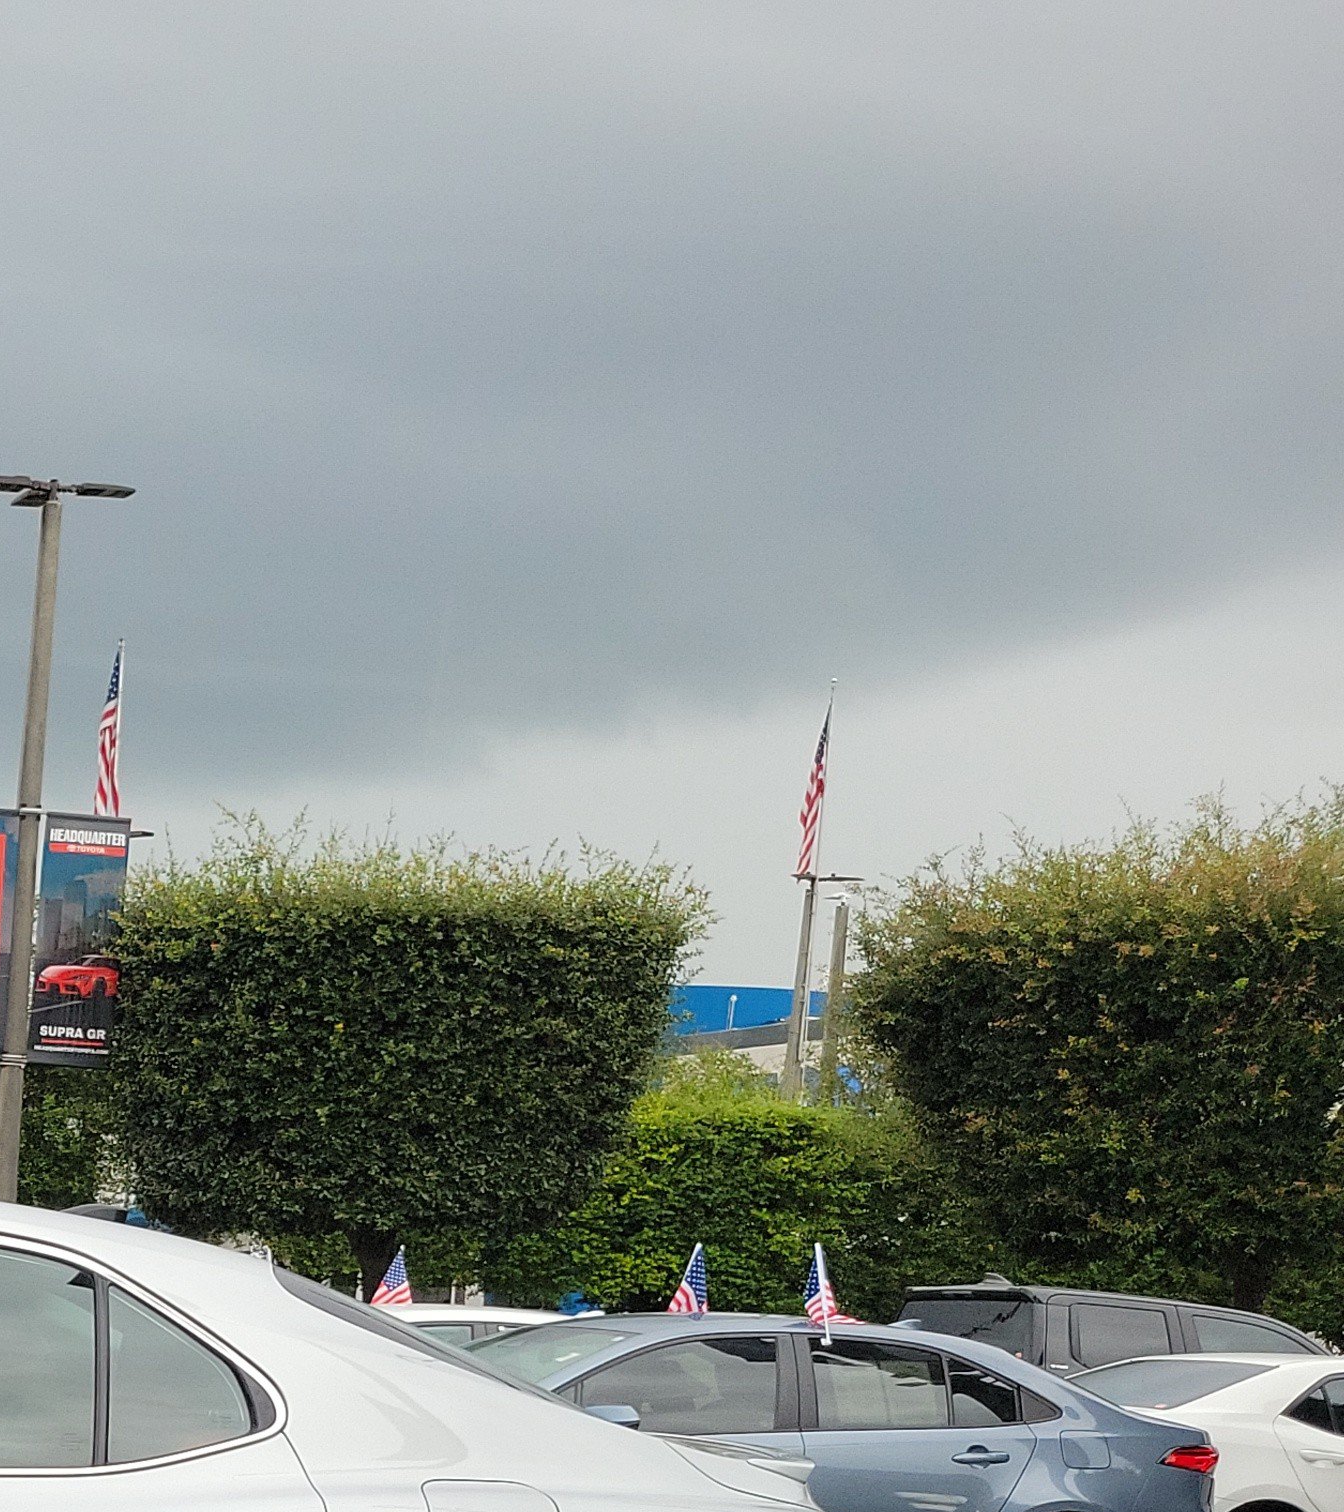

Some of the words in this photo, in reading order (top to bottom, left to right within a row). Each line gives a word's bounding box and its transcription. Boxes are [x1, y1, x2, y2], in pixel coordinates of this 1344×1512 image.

[49, 828, 126, 847] HEADQUARTER
[77, 846, 105, 854] TOYOTA
[39, 1025, 84, 1039] SUPRA
[86, 1028, 106, 1040] GR
